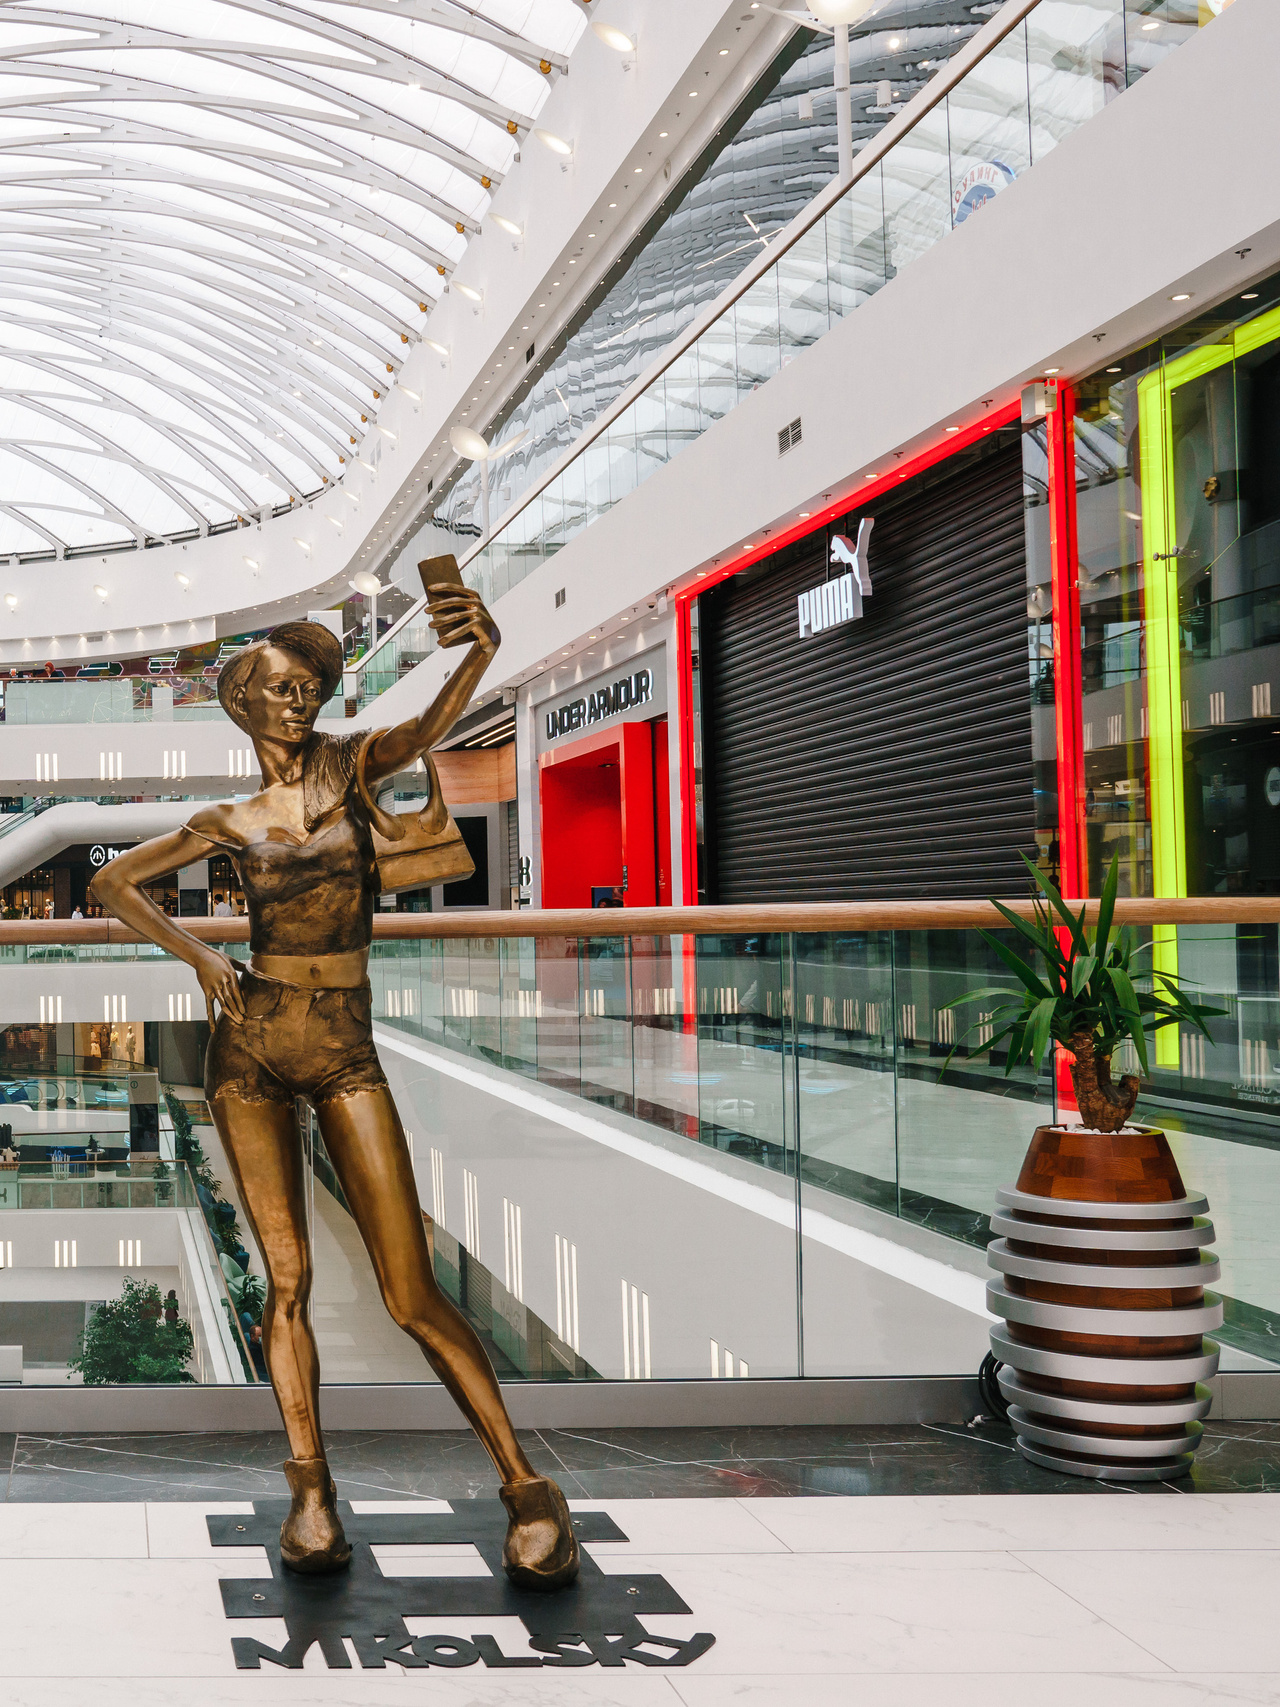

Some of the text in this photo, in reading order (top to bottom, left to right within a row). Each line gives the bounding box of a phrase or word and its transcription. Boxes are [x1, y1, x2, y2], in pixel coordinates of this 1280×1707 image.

[953, 166, 999, 208] ОУЛИНГ
[798, 573, 855, 638] PUMA
[546, 668, 654, 740] UNDER ARMOUR
[230, 1632, 717, 1669] MIKOLSKY
